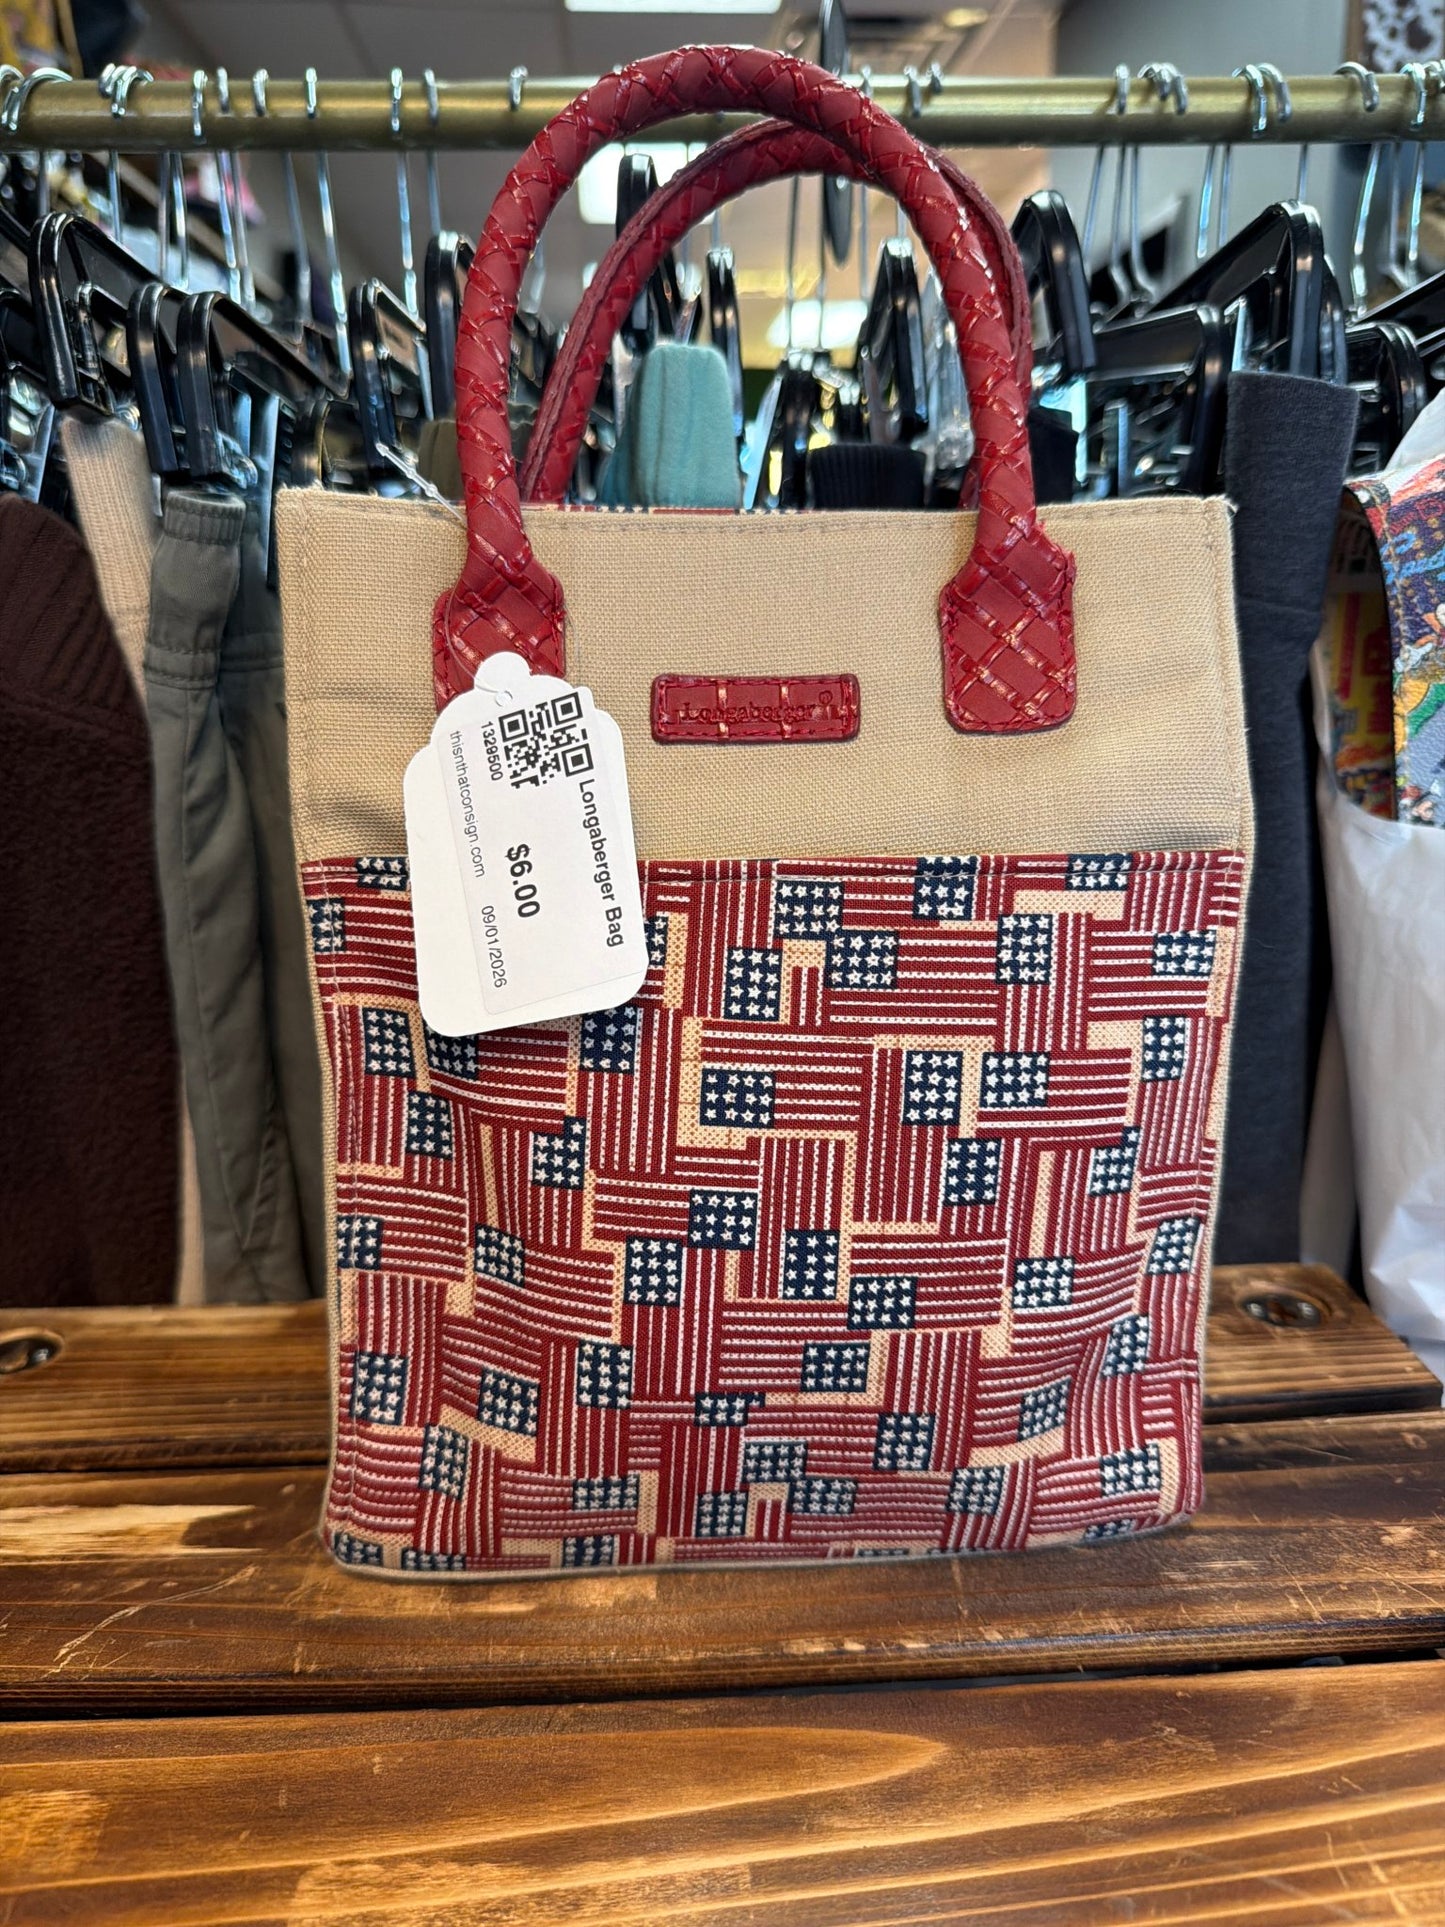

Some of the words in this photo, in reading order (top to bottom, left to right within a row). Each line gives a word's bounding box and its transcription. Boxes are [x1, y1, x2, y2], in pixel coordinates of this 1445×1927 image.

[450, 730, 486, 878] thisnthatconsign.com
[504, 843, 541, 919] $6.00
[579, 778, 615, 901] Longaberger
[604, 906, 624, 948] Bag
[481, 905, 508, 989] 09/01/2026
